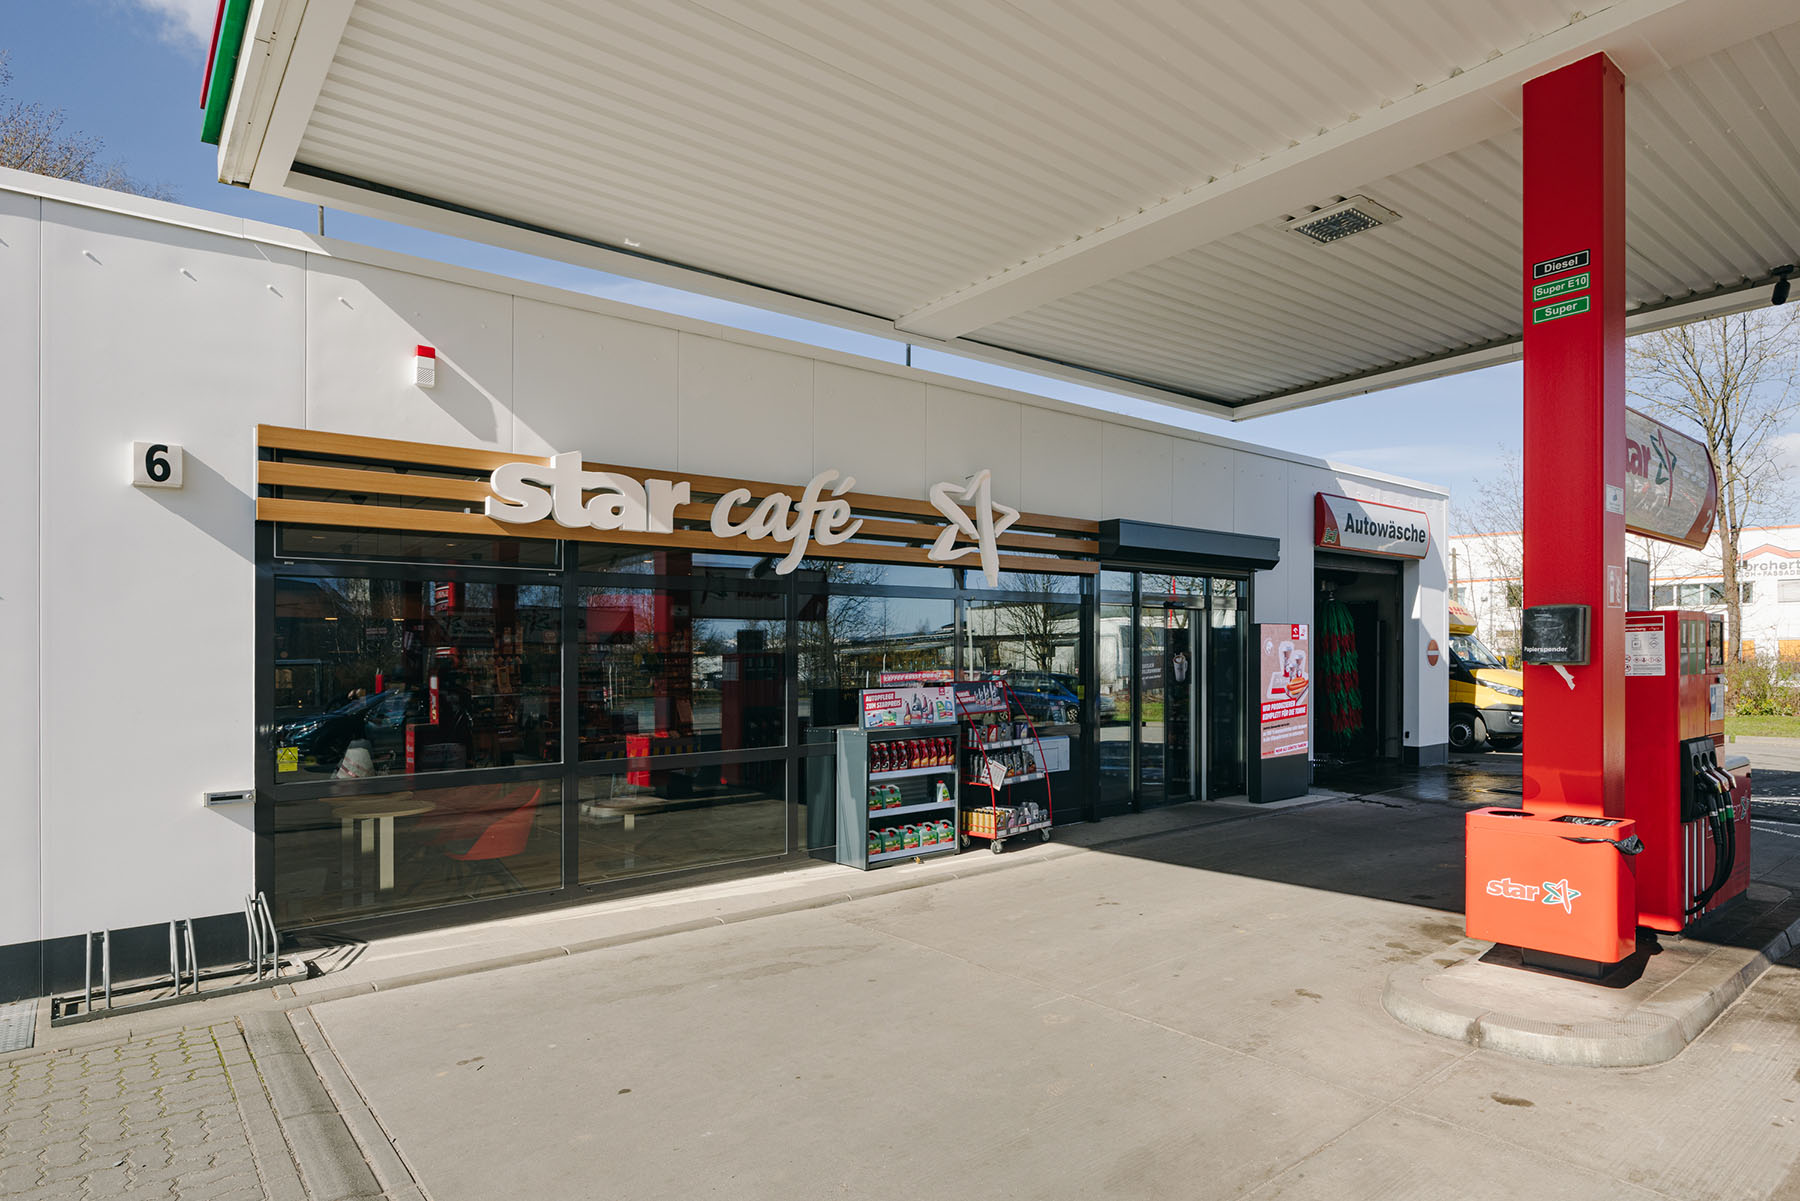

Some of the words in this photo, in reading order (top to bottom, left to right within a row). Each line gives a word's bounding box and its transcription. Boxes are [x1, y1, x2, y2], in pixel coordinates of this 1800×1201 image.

[1544, 256, 1578, 273] Diesel
[1536, 282, 1565, 296] Super
[1567, 276, 1586, 288] E10
[1544, 302, 1578, 316] Super
[145, 444, 171, 482] 6
[485, 450, 691, 534] star
[710, 469, 864, 576] café
[1702, 509, 1713, 533] 2
[1344, 512, 1426, 543] Autowäsche
[1743, 559, 1800, 571] orchert
[1486, 877, 1540, 901] star
